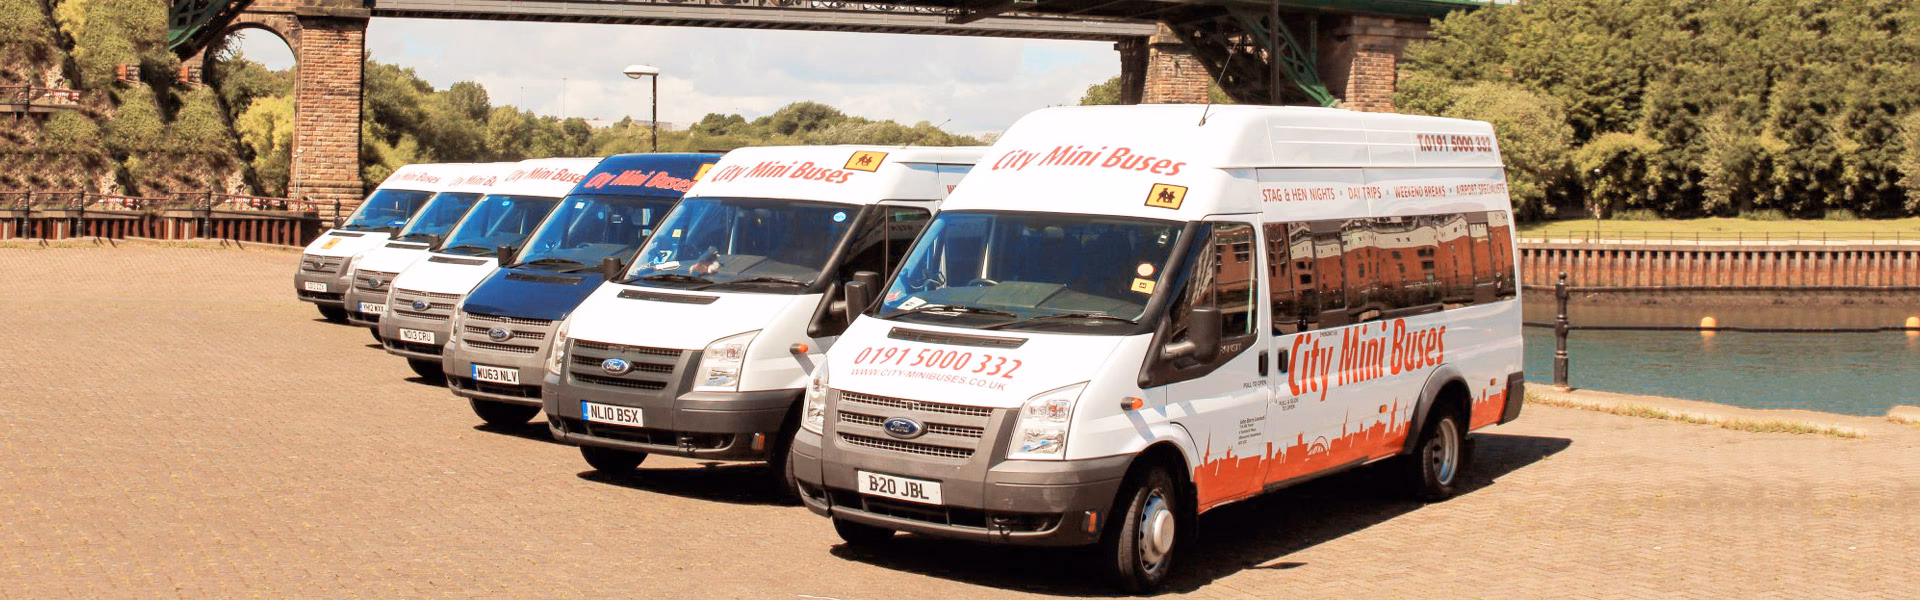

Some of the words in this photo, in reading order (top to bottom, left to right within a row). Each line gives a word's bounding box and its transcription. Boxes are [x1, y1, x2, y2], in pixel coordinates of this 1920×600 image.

[1417, 134, 1449, 152] T.0191
[1451, 135, 1475, 152] 5000
[1475, 136, 1492, 152] 332
[992, 149, 1041, 171] City
[1038, 145, 1108, 167] Mini
[1101, 147, 1187, 176] Buses
[505, 169, 527, 182] City
[526, 167, 558, 180] Mini
[551, 168, 585, 184] Buse
[584, 172, 616, 189] City
[609, 170, 655, 186] Mini
[711, 164, 750, 183] City
[749, 161, 798, 179] Mini
[790, 161, 855, 184] Buses
[1262, 189, 1282, 202] STAG
[1284, 189, 1291, 201] &
[1291, 188, 1308, 201] HEN
[1309, 187, 1335, 200] NIGHTS
[1348, 187, 1361, 200] DAY
[1361, 186, 1382, 199] TRIPS
[1394, 185, 1423, 198] WEEKEND
[1424, 185, 1446, 197] BREAKS
[854, 347, 911, 365] 0191
[910, 348, 972, 371] 5000
[972, 354, 1022, 379] 332
[1288, 333, 1334, 402] City
[1338, 321, 1388, 387] Mini
[1390, 318, 1447, 375] Buses
[477, 368, 498, 380] WU63
[500, 370, 517, 382] NLV
[851, 368, 1008, 391] WWW.CITY-MINIBUSES.CO.UK
[591, 405, 614, 420] NL10
[617, 408, 639, 423] BSX
[868, 475, 897, 495] B20
[900, 481, 929, 500] JBL
